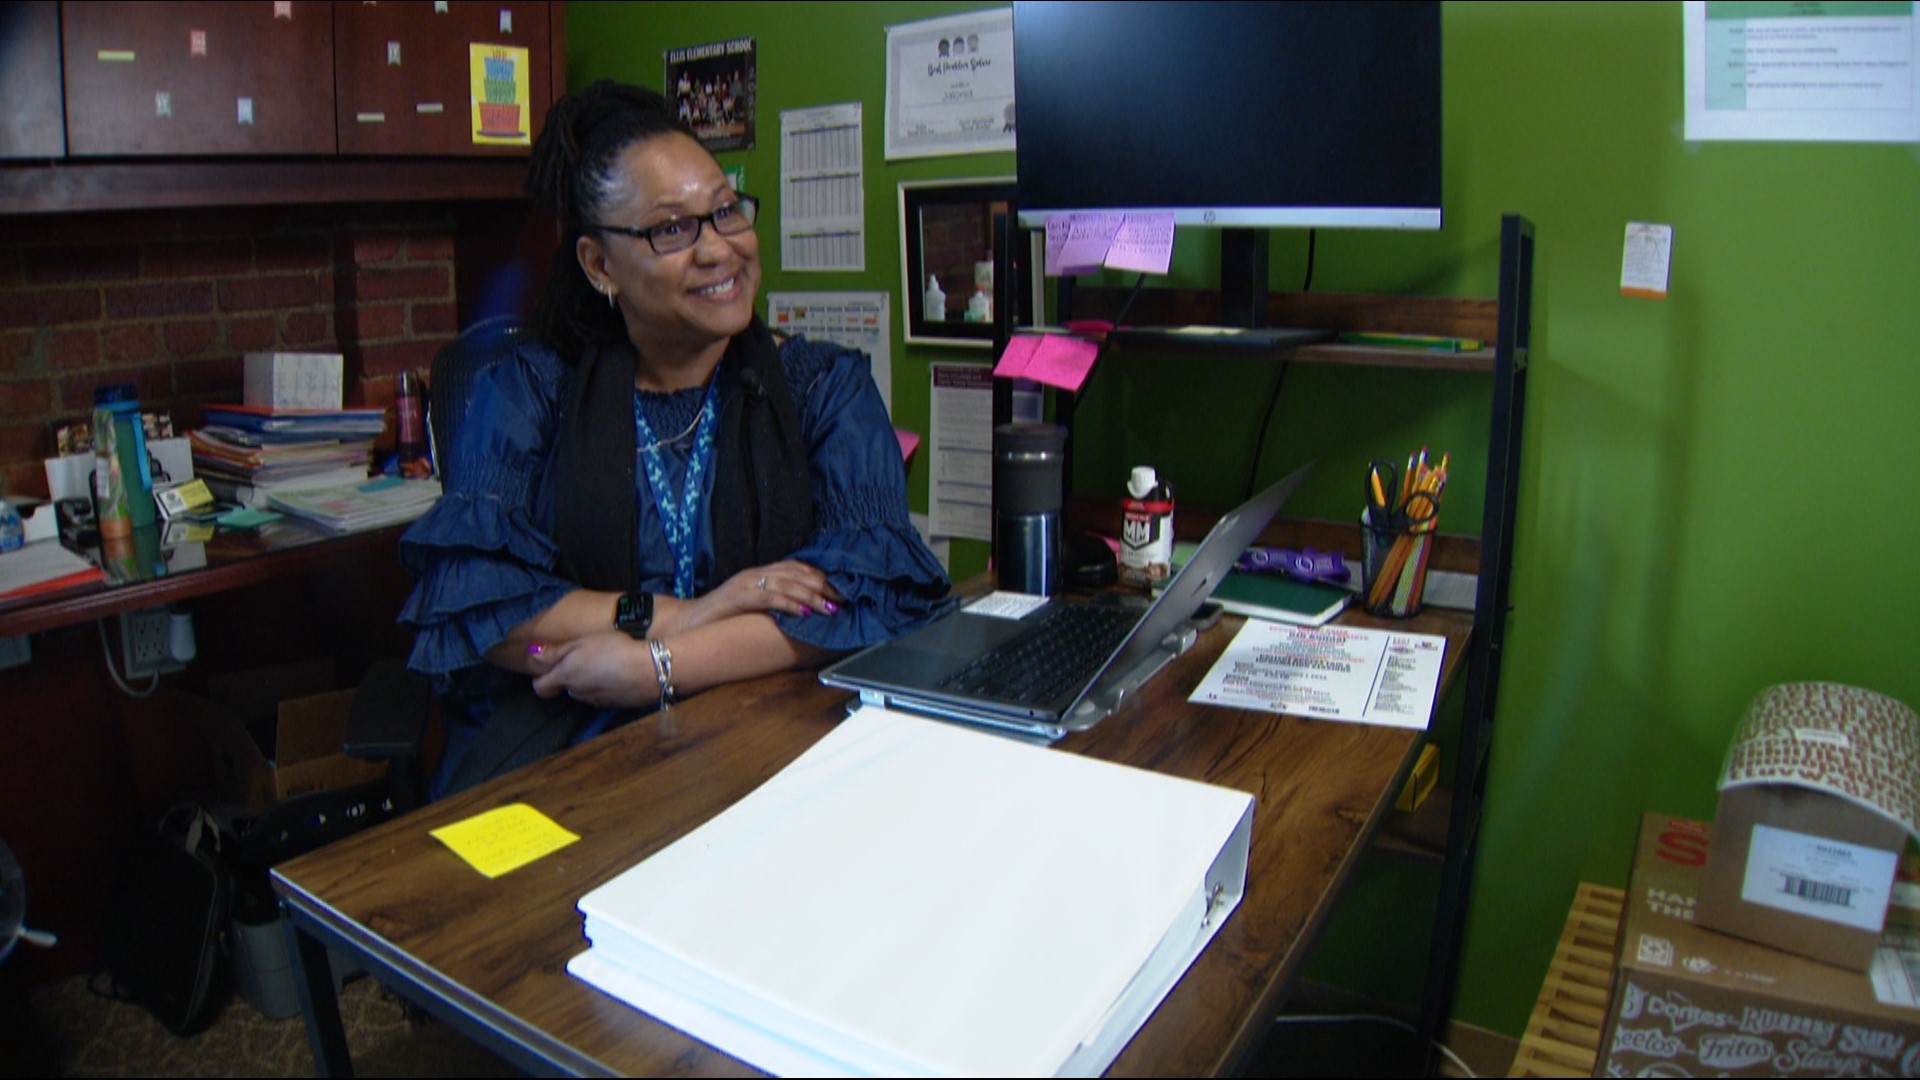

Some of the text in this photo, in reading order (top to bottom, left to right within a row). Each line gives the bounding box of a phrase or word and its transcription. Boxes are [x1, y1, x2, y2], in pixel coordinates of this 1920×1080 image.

[687, 43, 725, 61] ELEMENTARY
[726, 38, 752, 54] SCHOOL
[1701, 1036, 1769, 1061] Fritos
